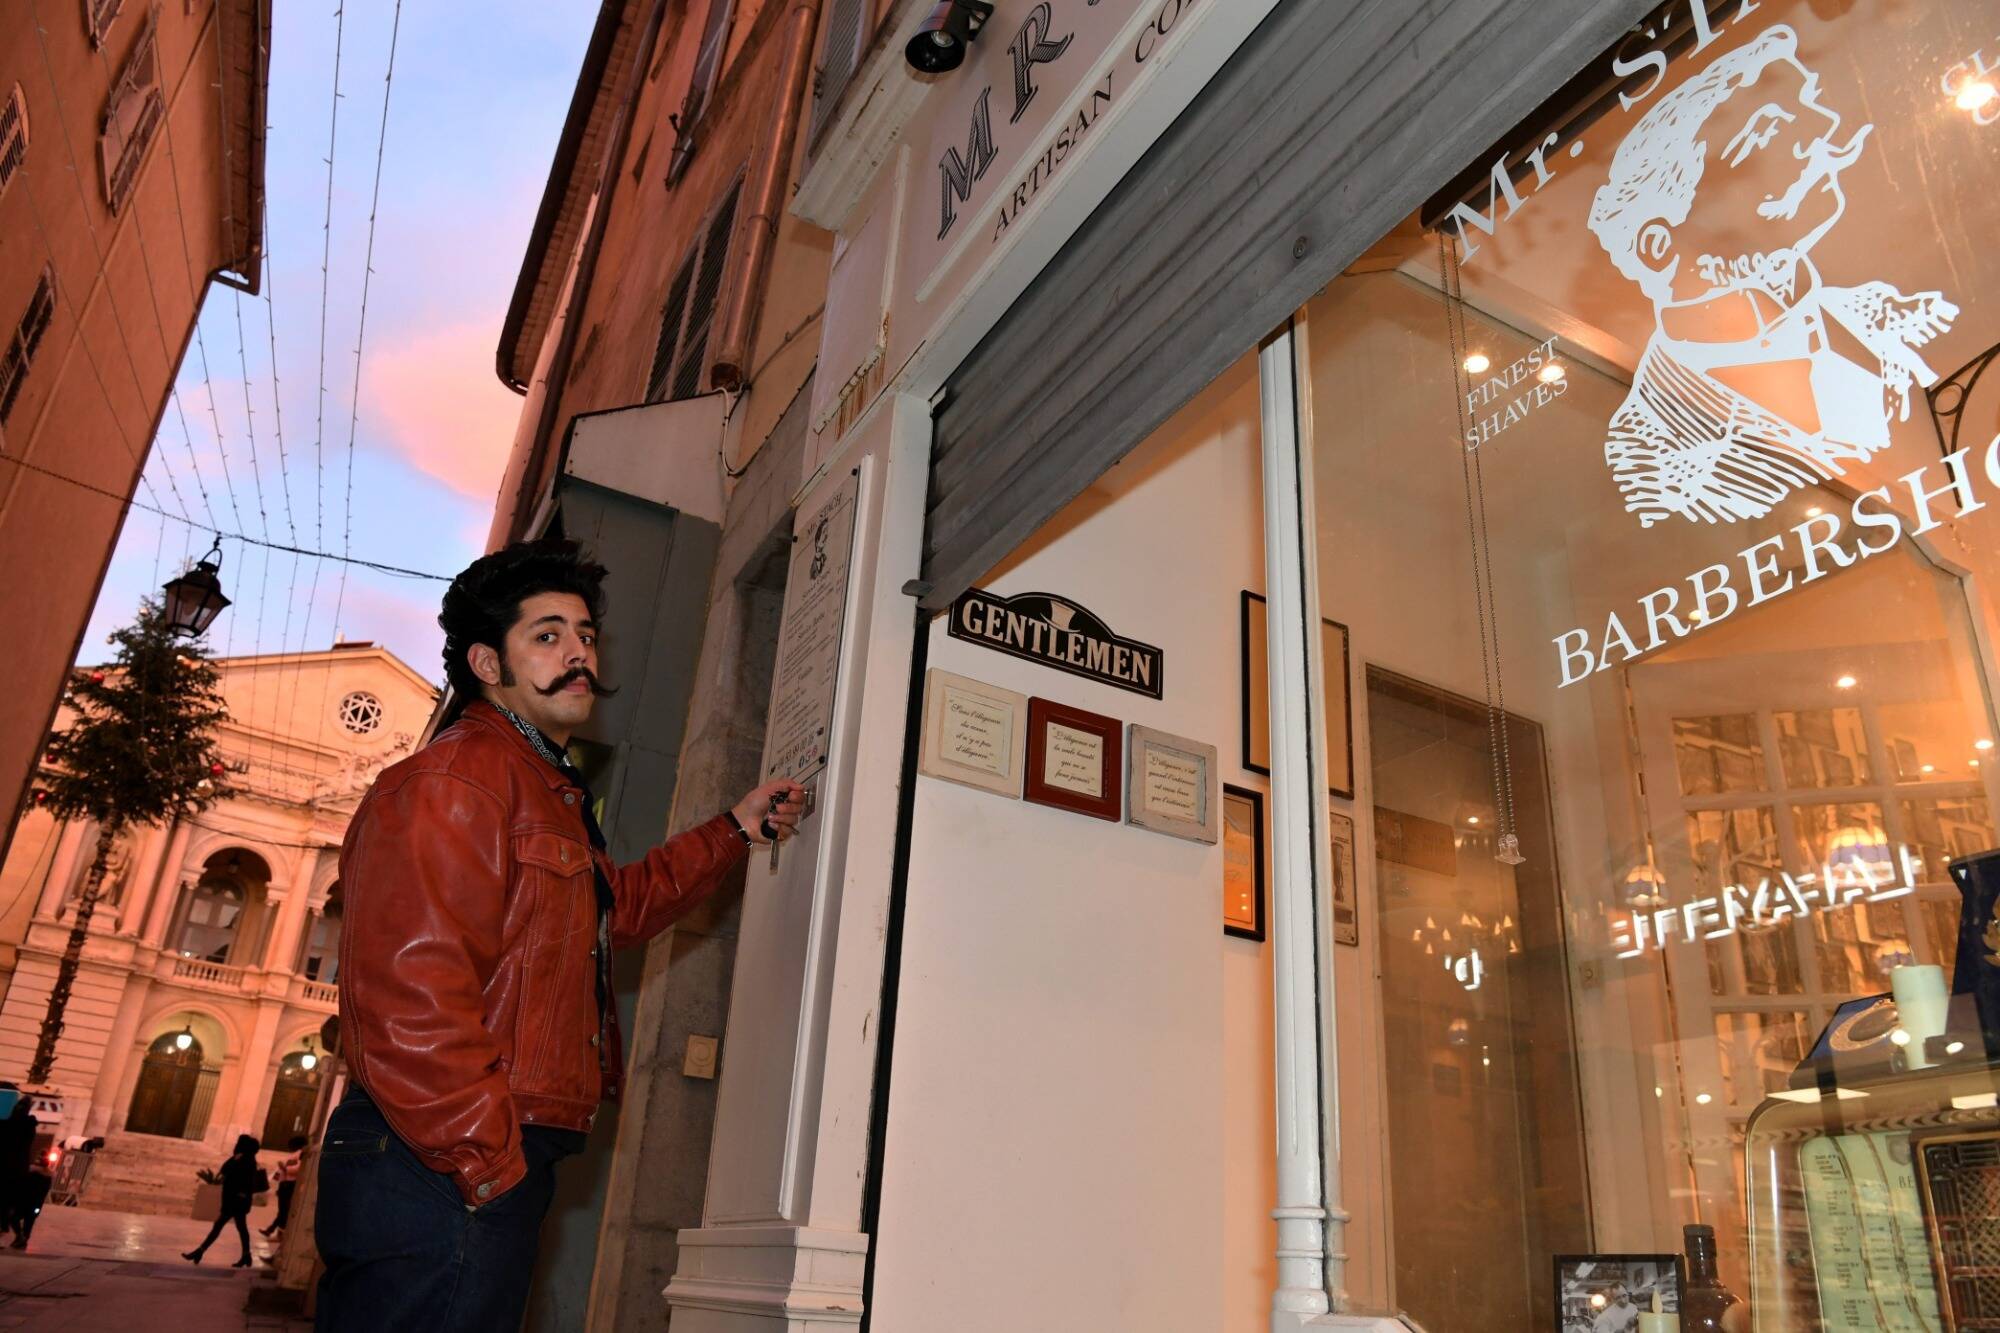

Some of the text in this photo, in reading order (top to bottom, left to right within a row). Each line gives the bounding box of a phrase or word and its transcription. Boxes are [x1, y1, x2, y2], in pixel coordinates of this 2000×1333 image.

[992, 0, 1193, 244] ARTISAN CO
[1444, 0, 1761, 266] Mr. ST
[1465, 335, 1559, 416] FINEST
[1466, 377, 1568, 452] SHAVES
[962, 599, 1152, 686] GENTLEMEN
